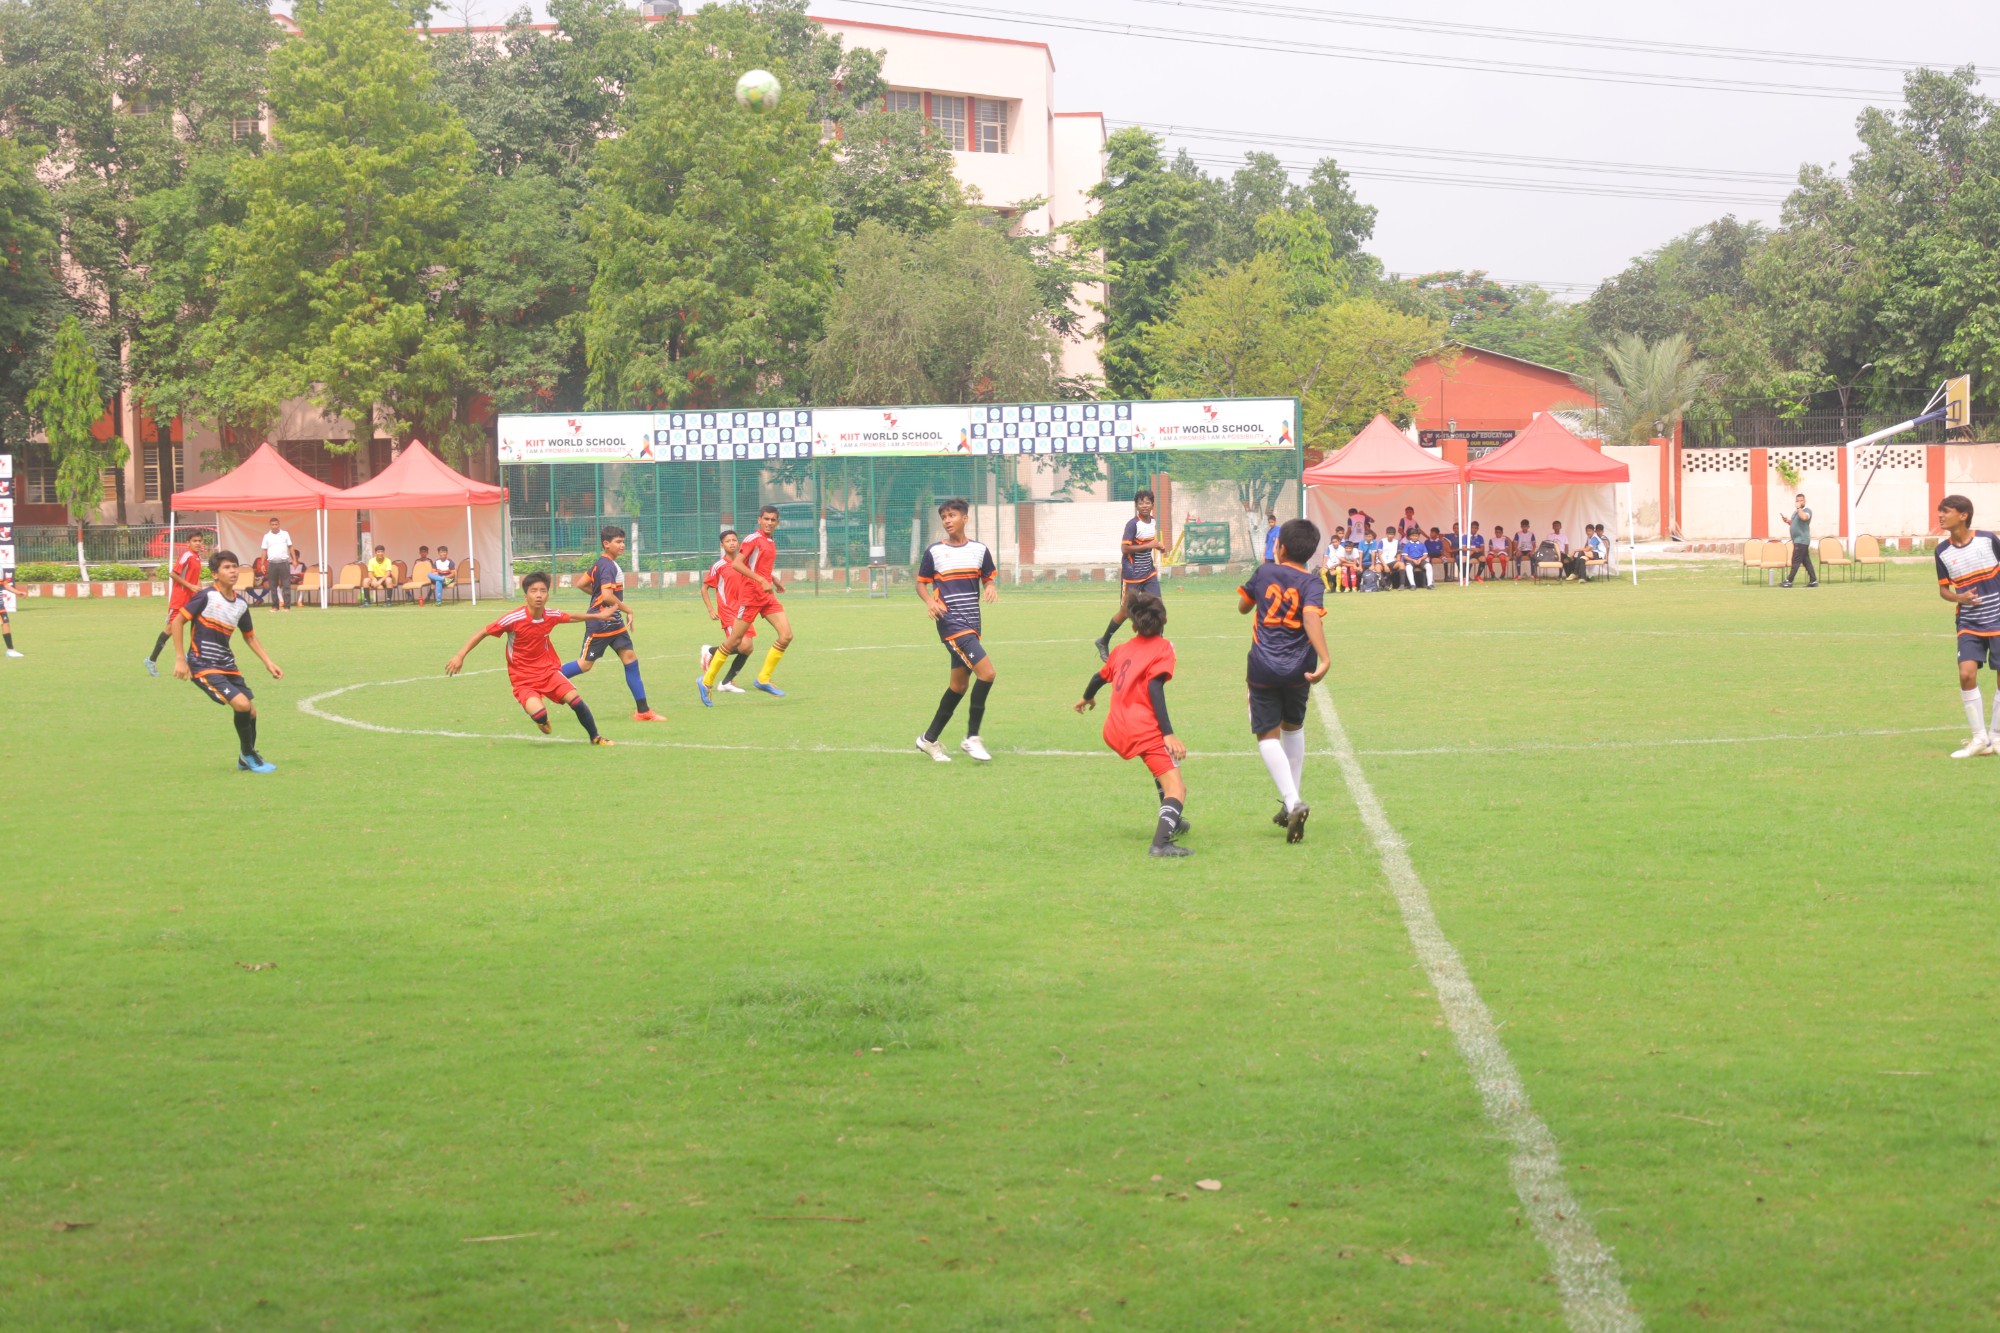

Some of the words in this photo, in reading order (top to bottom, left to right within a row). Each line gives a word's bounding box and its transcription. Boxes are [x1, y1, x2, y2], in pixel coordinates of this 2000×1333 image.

[1159, 426, 1179, 434] KIIT
[1183, 425, 1219, 433] WORLD
[1222, 424, 1264, 432] SCHOOL
[840, 433, 860, 441] KIIT
[863, 432, 899, 440] WORLD
[526, 439, 545, 447] KIIT
[586, 438, 626, 446] SCHOOL
[1263, 584, 1301, 629] 22
[1115, 659, 1132, 692] 8
